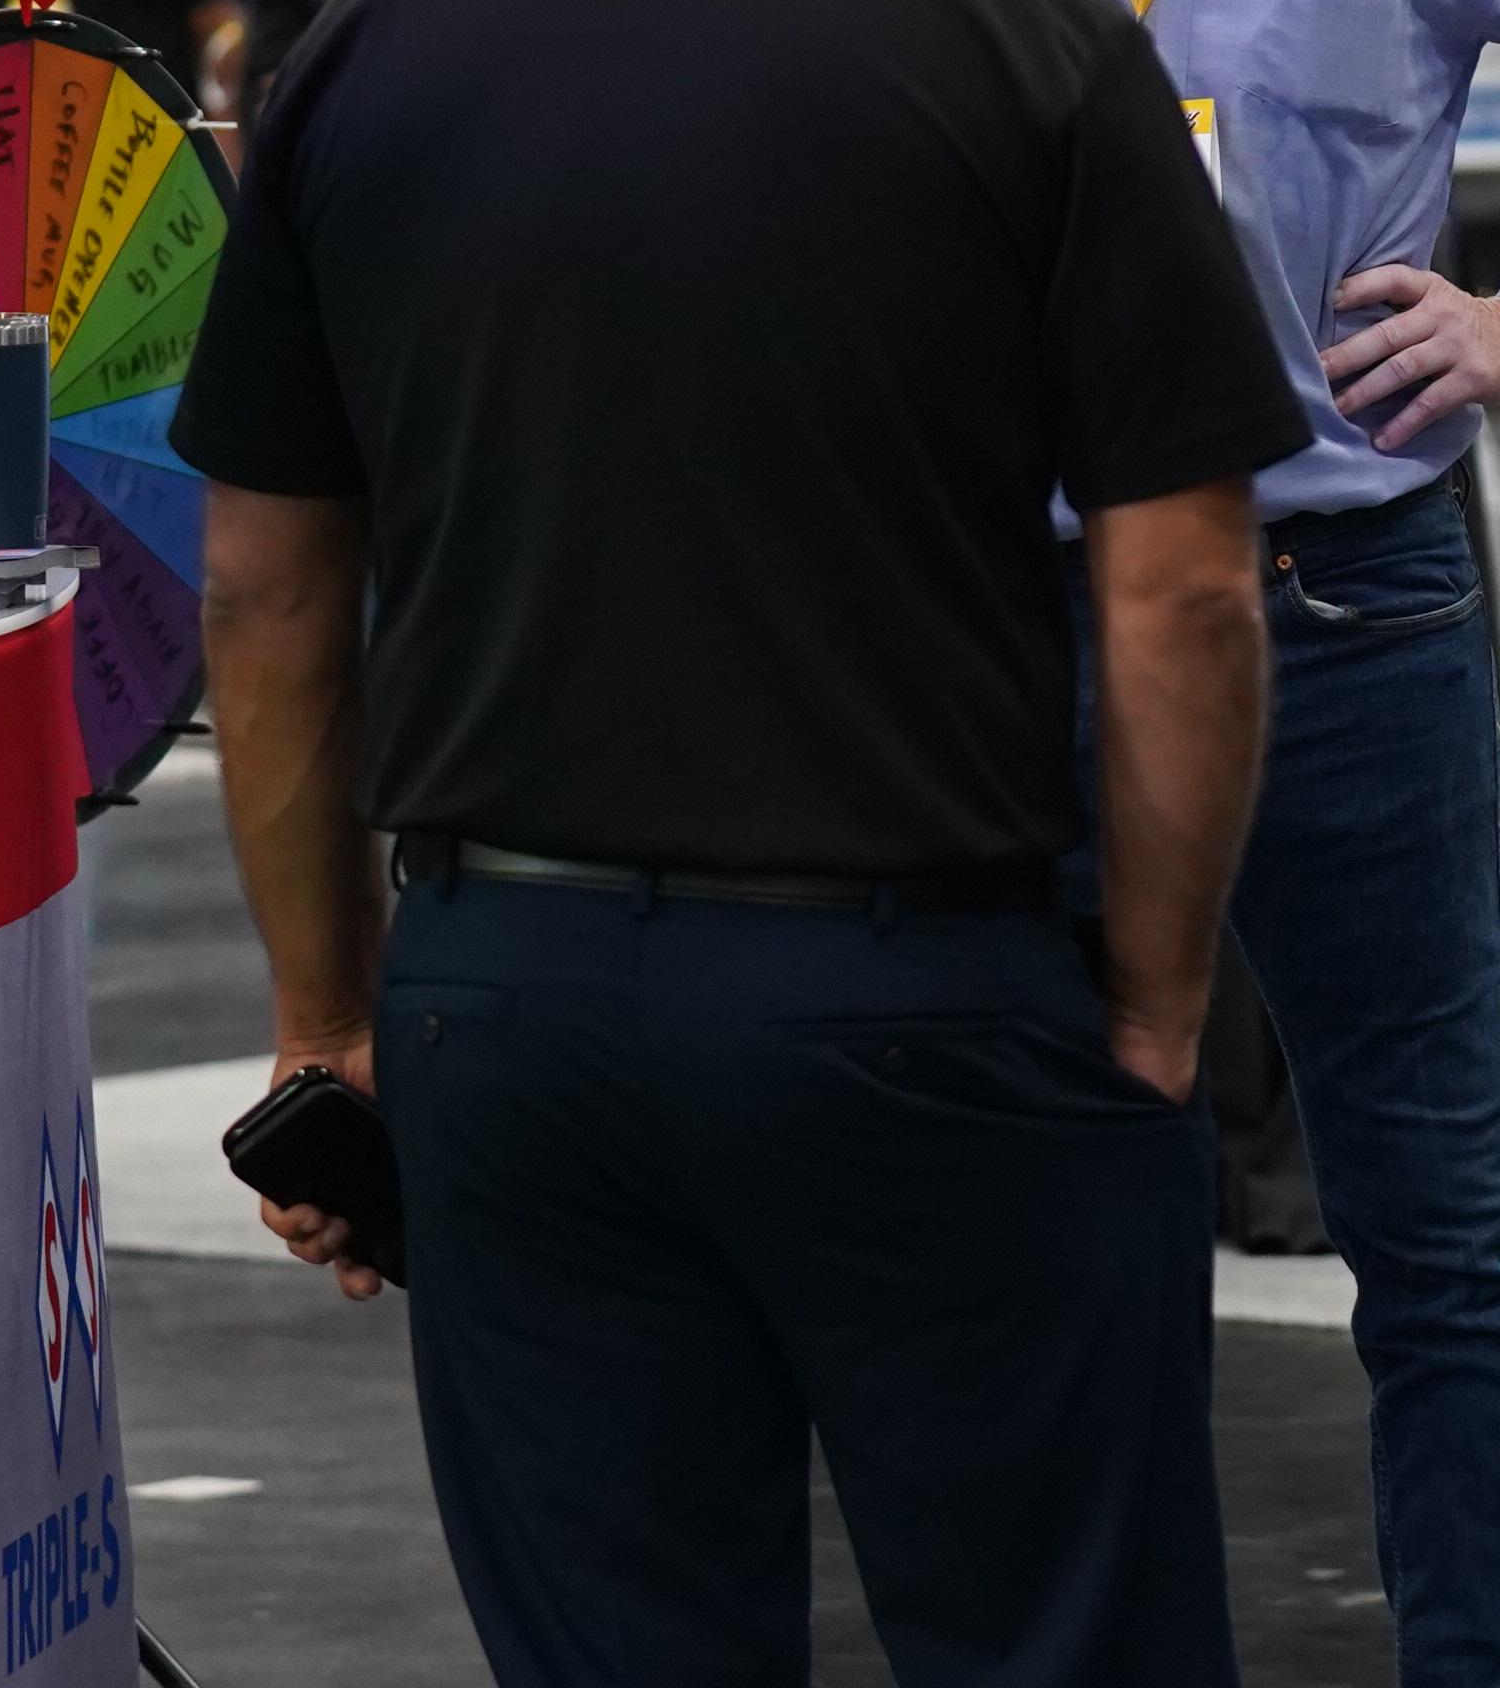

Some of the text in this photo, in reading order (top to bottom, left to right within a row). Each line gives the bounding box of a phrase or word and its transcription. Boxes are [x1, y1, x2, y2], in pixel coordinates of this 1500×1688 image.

[126, 188, 205, 298] MUG
[99, 328, 198, 395] TUMBLE
[2, 1473, 121, 1677] TRIPLE-S
